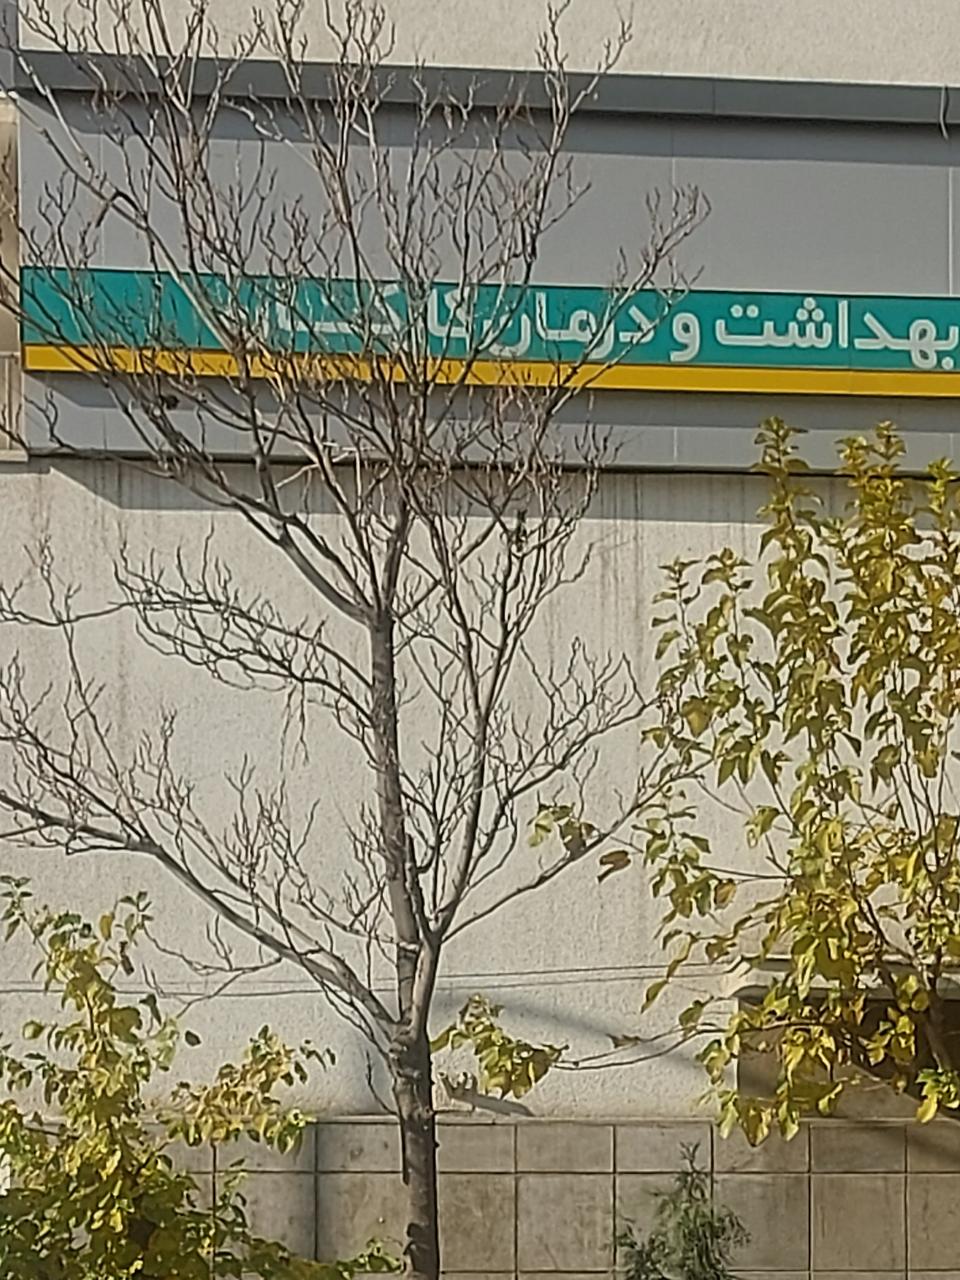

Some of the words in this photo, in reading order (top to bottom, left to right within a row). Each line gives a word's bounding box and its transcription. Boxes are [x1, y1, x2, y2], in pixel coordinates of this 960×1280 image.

[482, 291, 655, 360] درمان
[669, 311, 701, 363] و
[714, 297, 959, 370] بهداشت
